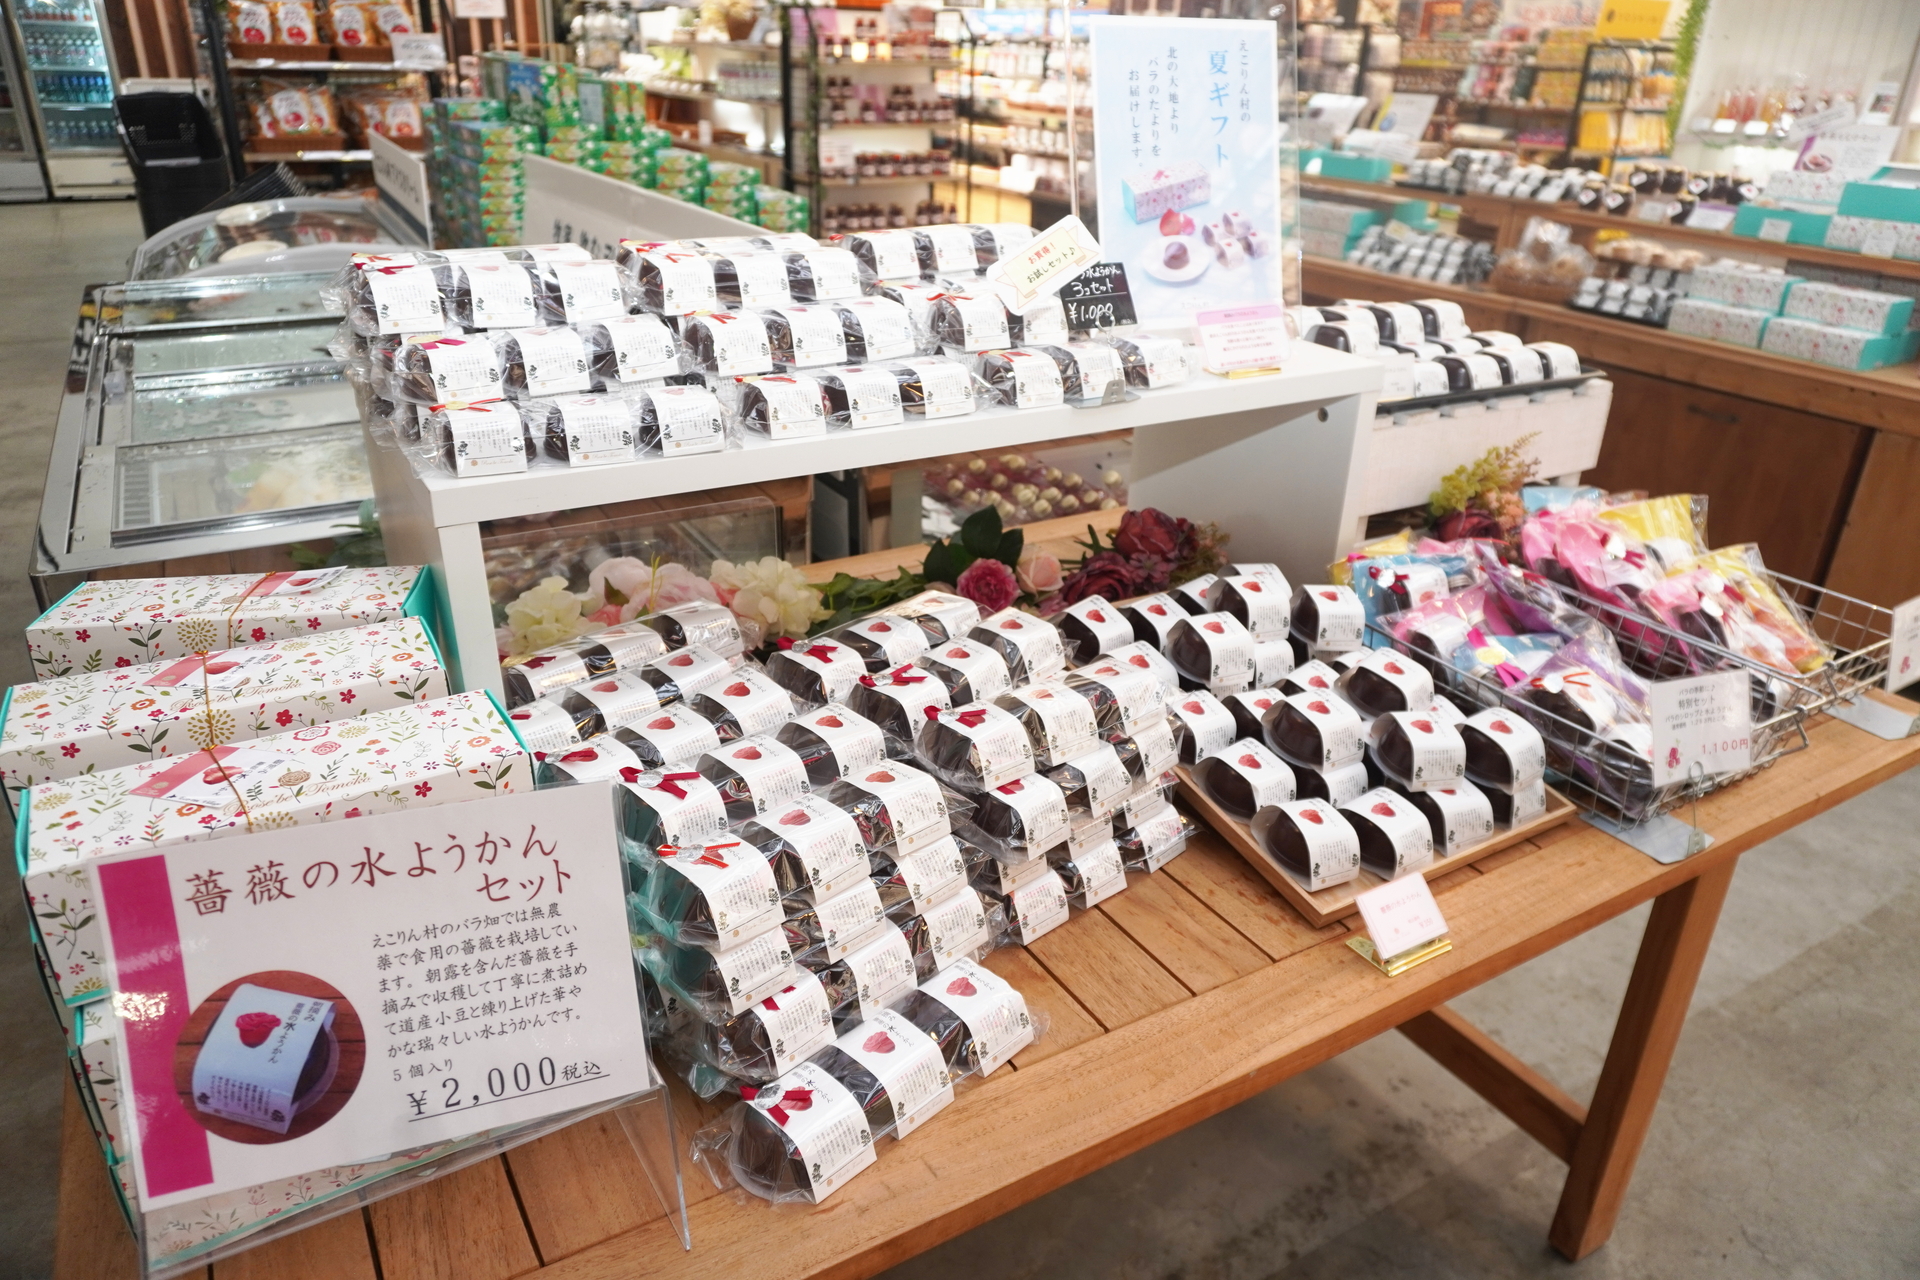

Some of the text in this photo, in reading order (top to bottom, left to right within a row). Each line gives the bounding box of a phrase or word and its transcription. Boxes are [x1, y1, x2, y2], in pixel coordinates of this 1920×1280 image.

[1148, 57, 1161, 157] バラのたよりを
[1167, 46, 1179, 134] 北の大地より
[1239, 40, 1251, 122] えこりん村の
[1128, 69, 1144, 167] お届けします。
[1208, 50, 1230, 168] 夏ギフト
[185, 824, 558, 916] 薔薇の水ようかん
[476, 858, 571, 902] セット
[372, 902, 563, 948] えこりん村のバラ畑では無農
[376, 923, 578, 970] 薬で食用の薔薇を栽培してい
[378, 941, 579, 993] ます。朝露を含んだ薔薇を手
[381, 962, 588, 1015] 摘みで収穫して丁寧に煮詰め
[384, 984, 582, 1036] て道産小豆と練り上げた華や
[387, 1008, 581, 1059] かな瑞々しい水ようかんです。
